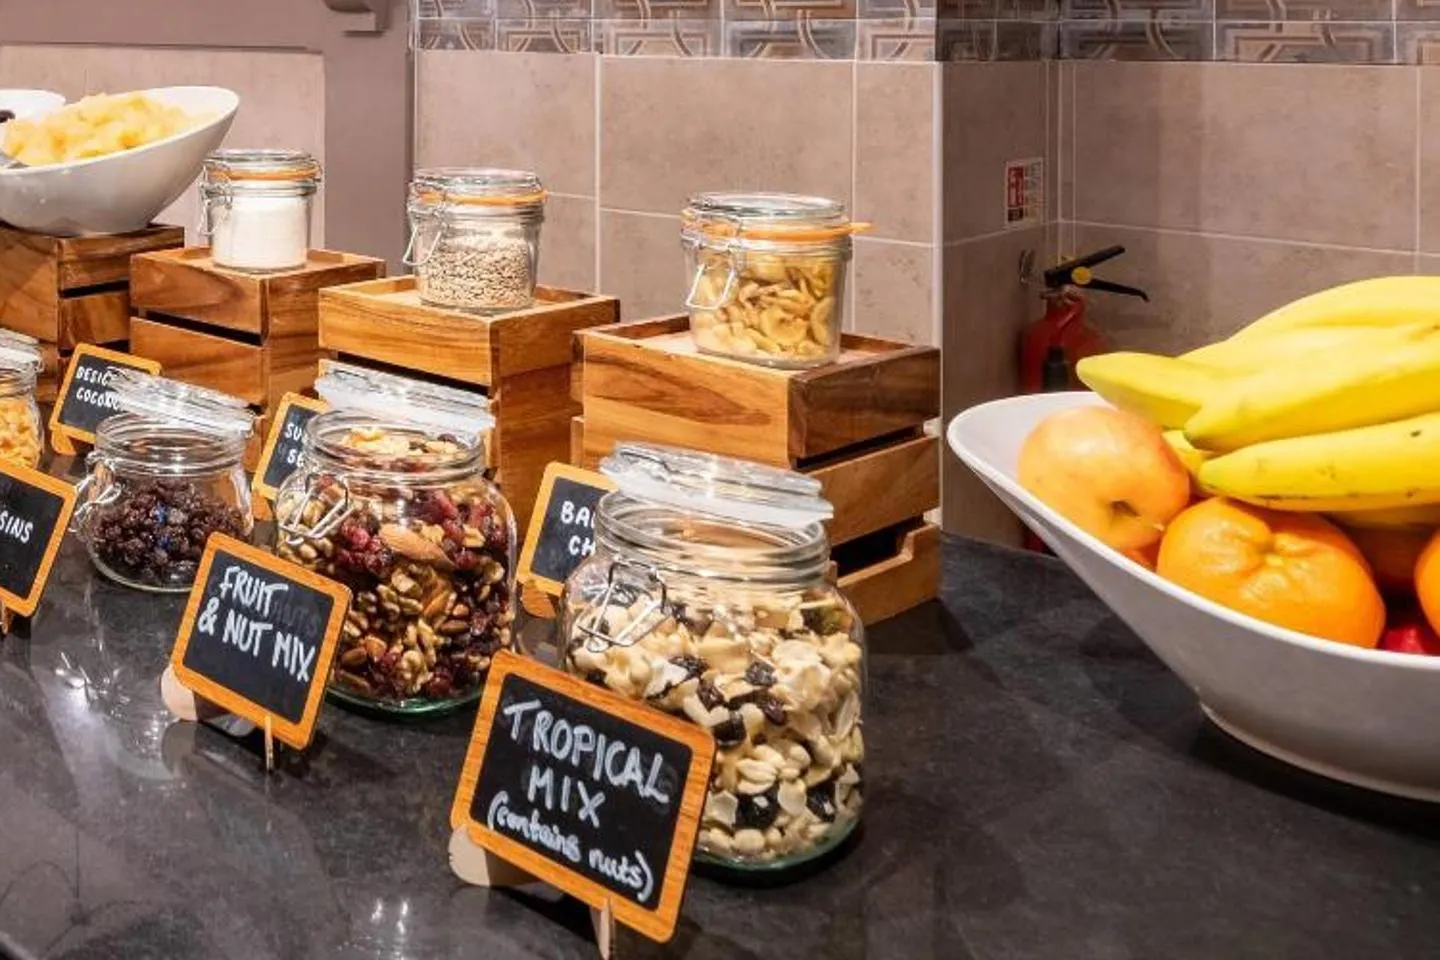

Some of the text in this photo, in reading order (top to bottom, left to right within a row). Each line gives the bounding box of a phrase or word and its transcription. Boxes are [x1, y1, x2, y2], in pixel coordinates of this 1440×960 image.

[76, 366, 111, 386] DESIC
[76, 387, 121, 411] COCONU
[284, 422, 308, 444] SU
[568, 534, 597, 556] CH
[219, 565, 289, 618] FRUIT
[197, 596, 316, 683] & NUT MIX
[503, 699, 669, 804] TROPICAL
[527, 764, 606, 828] MIX
[486, 790, 654, 902] (contains nuts)
